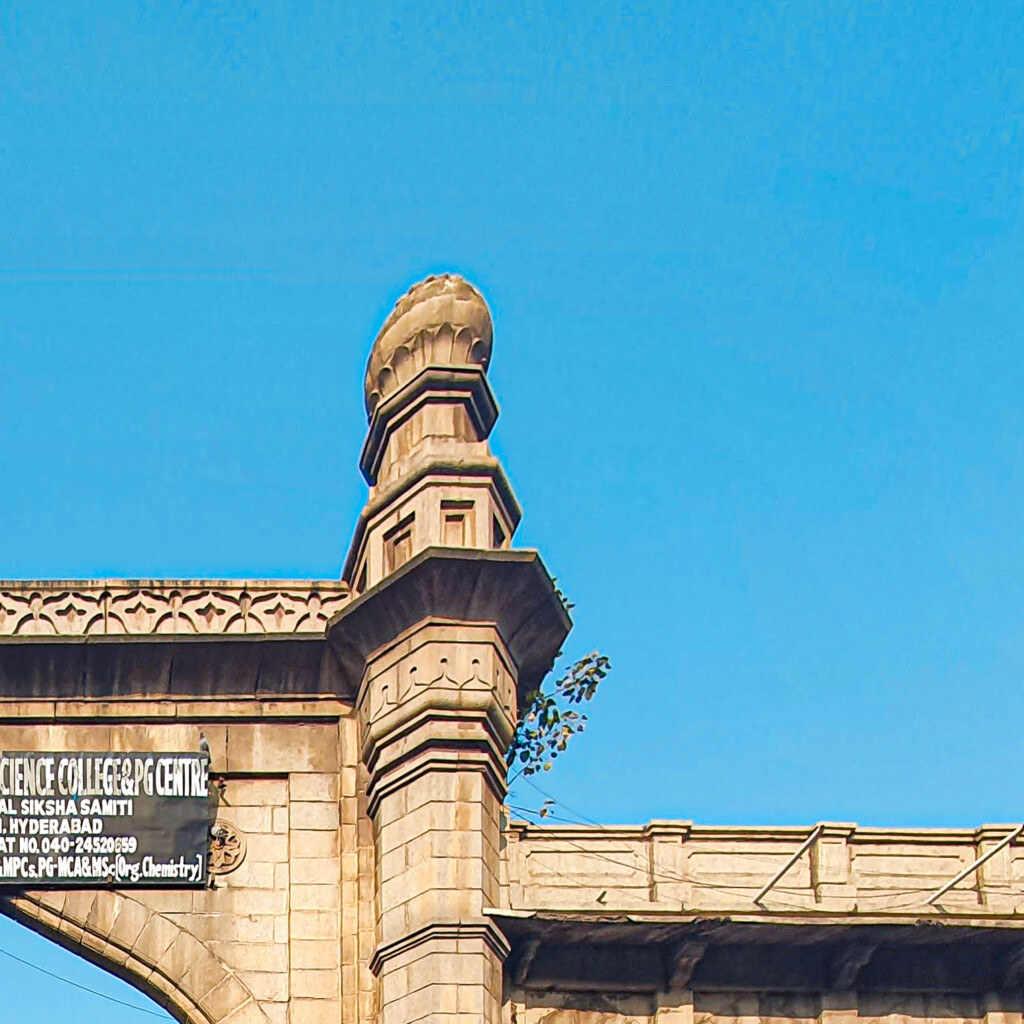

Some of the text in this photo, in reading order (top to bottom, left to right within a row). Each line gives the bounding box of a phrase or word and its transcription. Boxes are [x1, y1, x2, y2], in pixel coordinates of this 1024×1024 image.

[155, 758, 209, 797] CENTRE
[20, 799, 76, 816] SIKSHA
[80, 799, 133, 816] SAMITI
[9, 818, 103, 835] HYDERABAD
